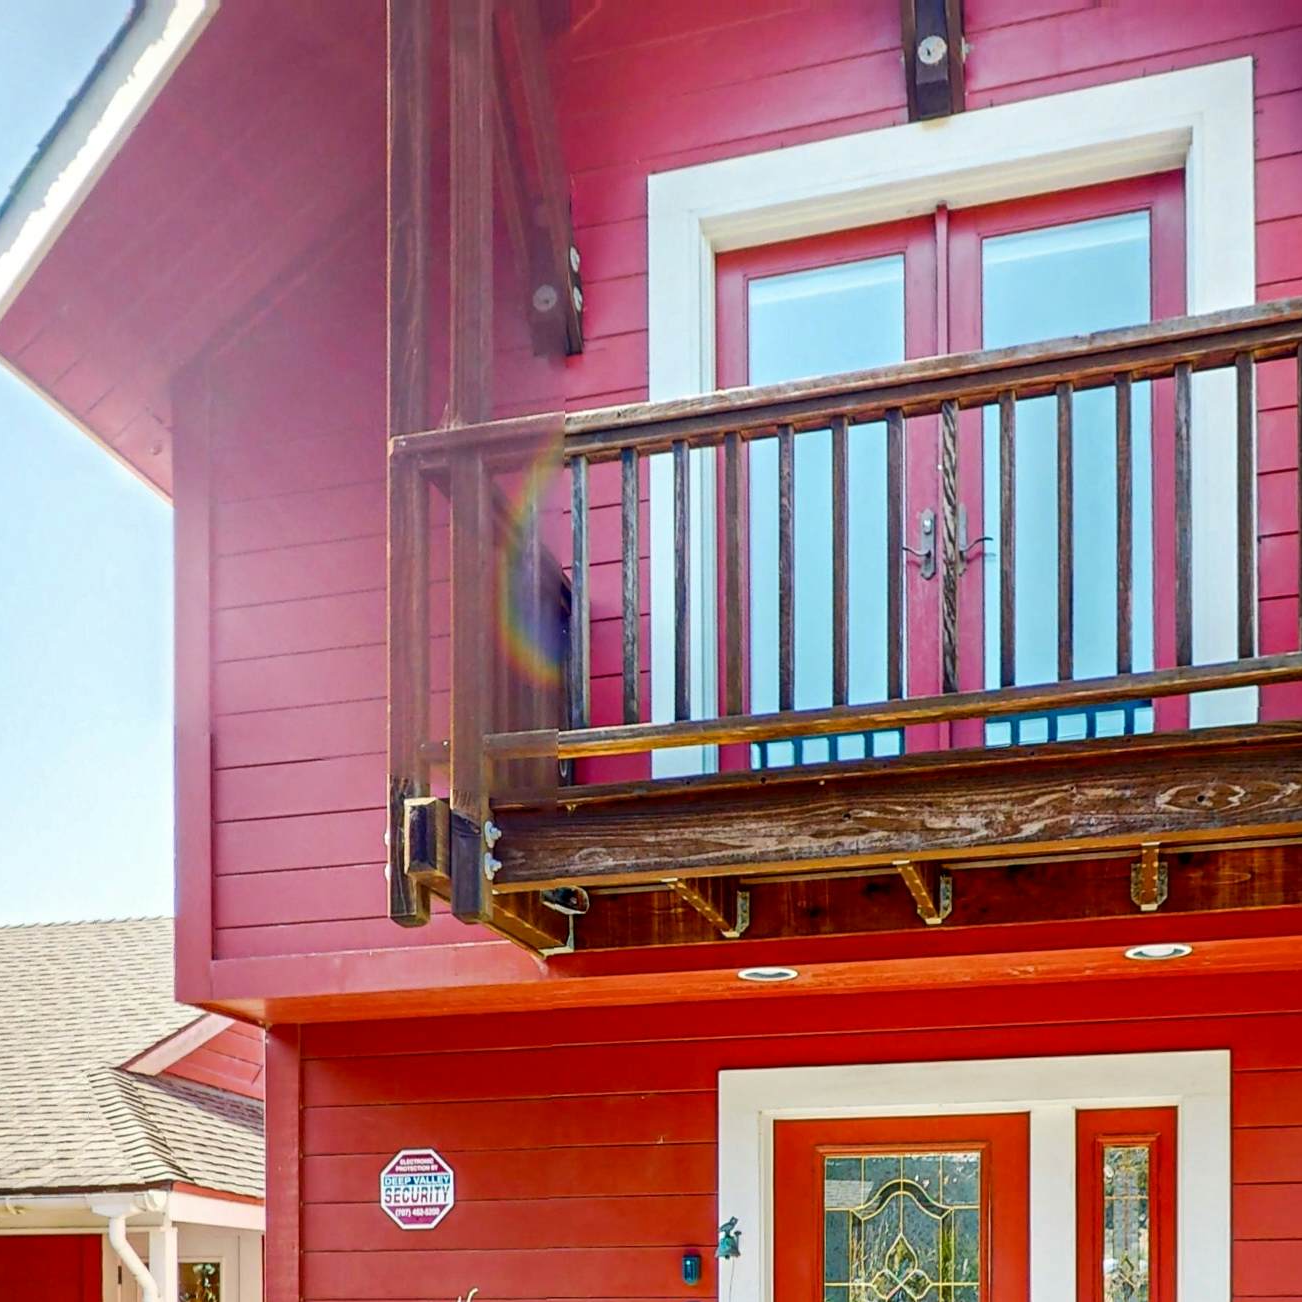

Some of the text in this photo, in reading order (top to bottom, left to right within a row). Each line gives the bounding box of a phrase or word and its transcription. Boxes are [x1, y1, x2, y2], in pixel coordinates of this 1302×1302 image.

[385, 1175, 449, 1185] DEEP VALLEY
[384, 1186, 449, 1203] SECURITY
